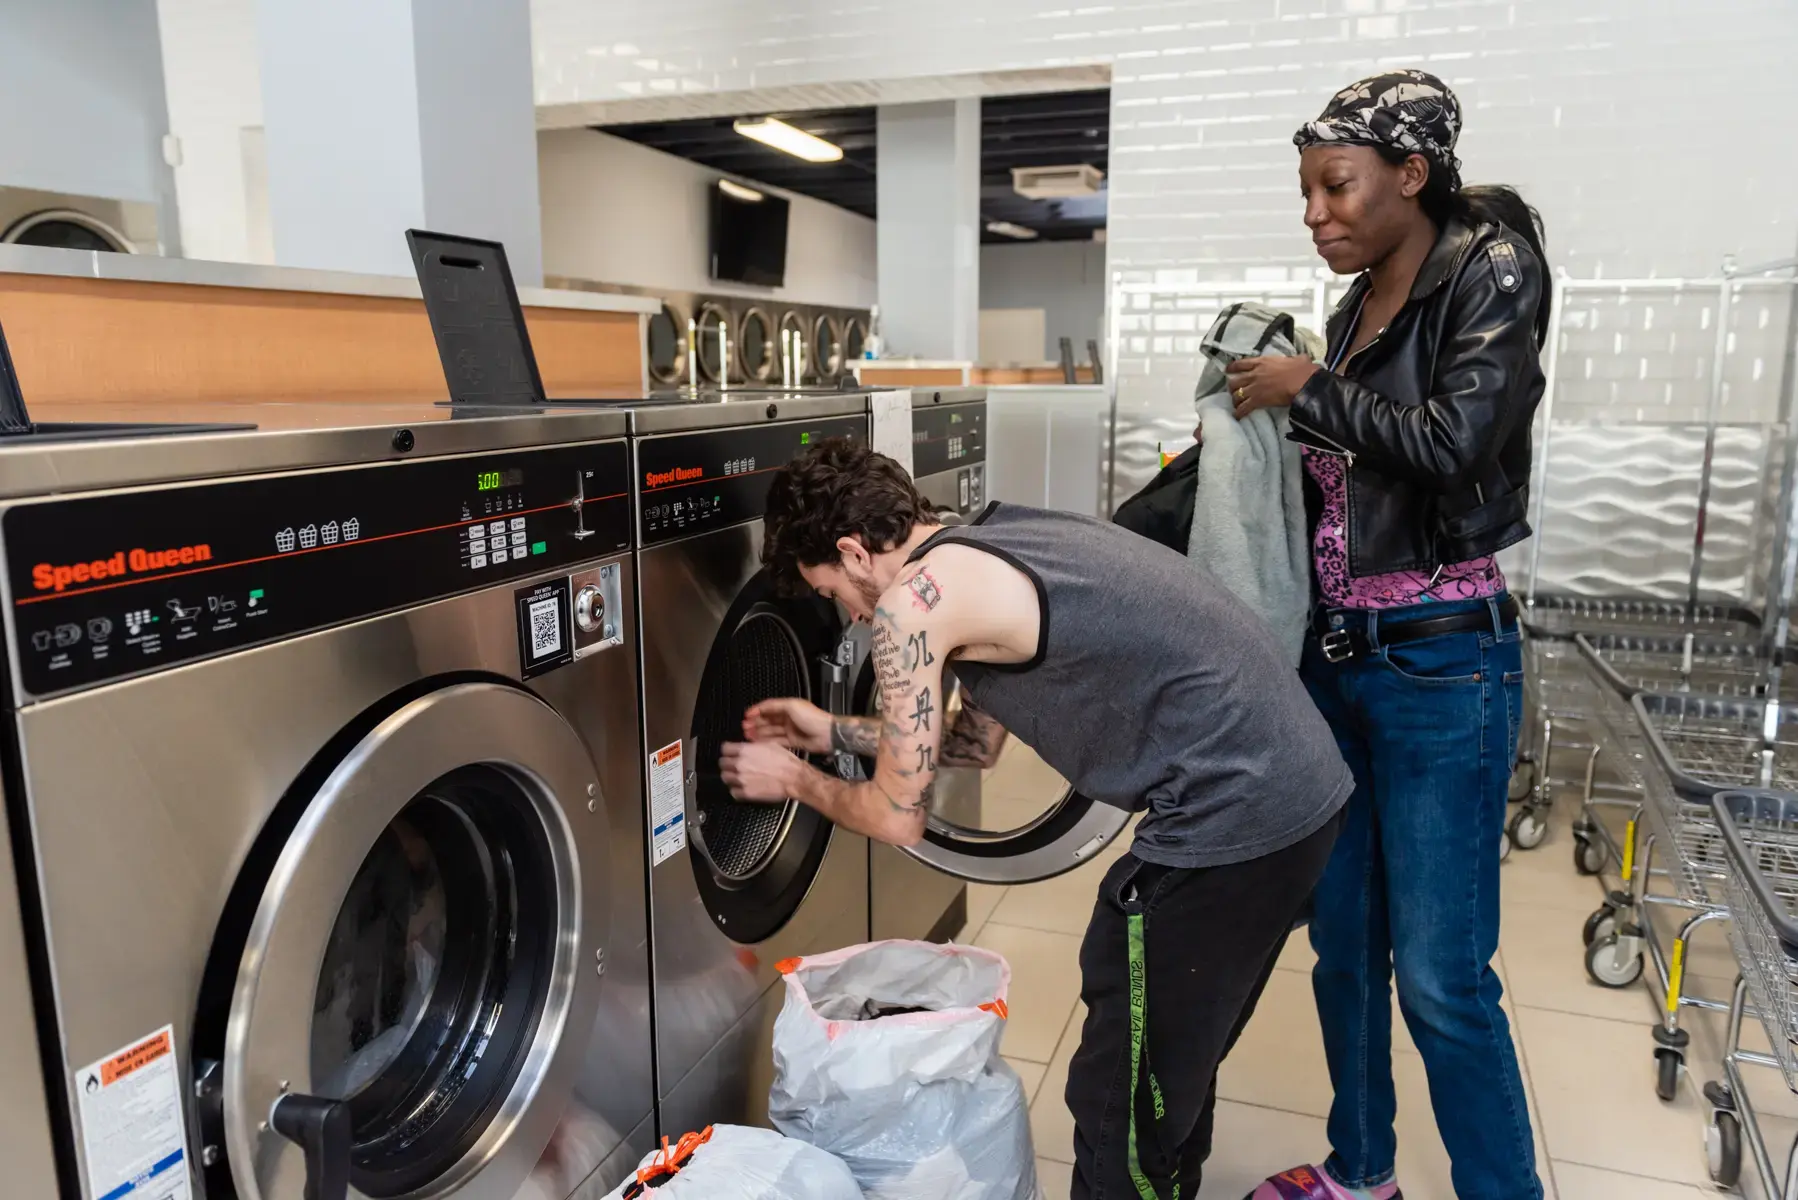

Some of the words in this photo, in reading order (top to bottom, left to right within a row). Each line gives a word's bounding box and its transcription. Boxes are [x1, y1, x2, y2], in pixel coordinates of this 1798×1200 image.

[646, 468, 675, 488] Speed
[675, 467, 703, 481] Queen
[32, 551, 126, 592] Speed
[128, 543, 213, 573] Queen
[526, 595, 539, 604] SPEED
[552, 589, 560, 597] APP
[534, 588, 543, 596] PAY
[542, 585, 552, 593] WITH
[115, 1035, 163, 1065] WARNING
[1149, 1072, 1165, 1120] BONDS
